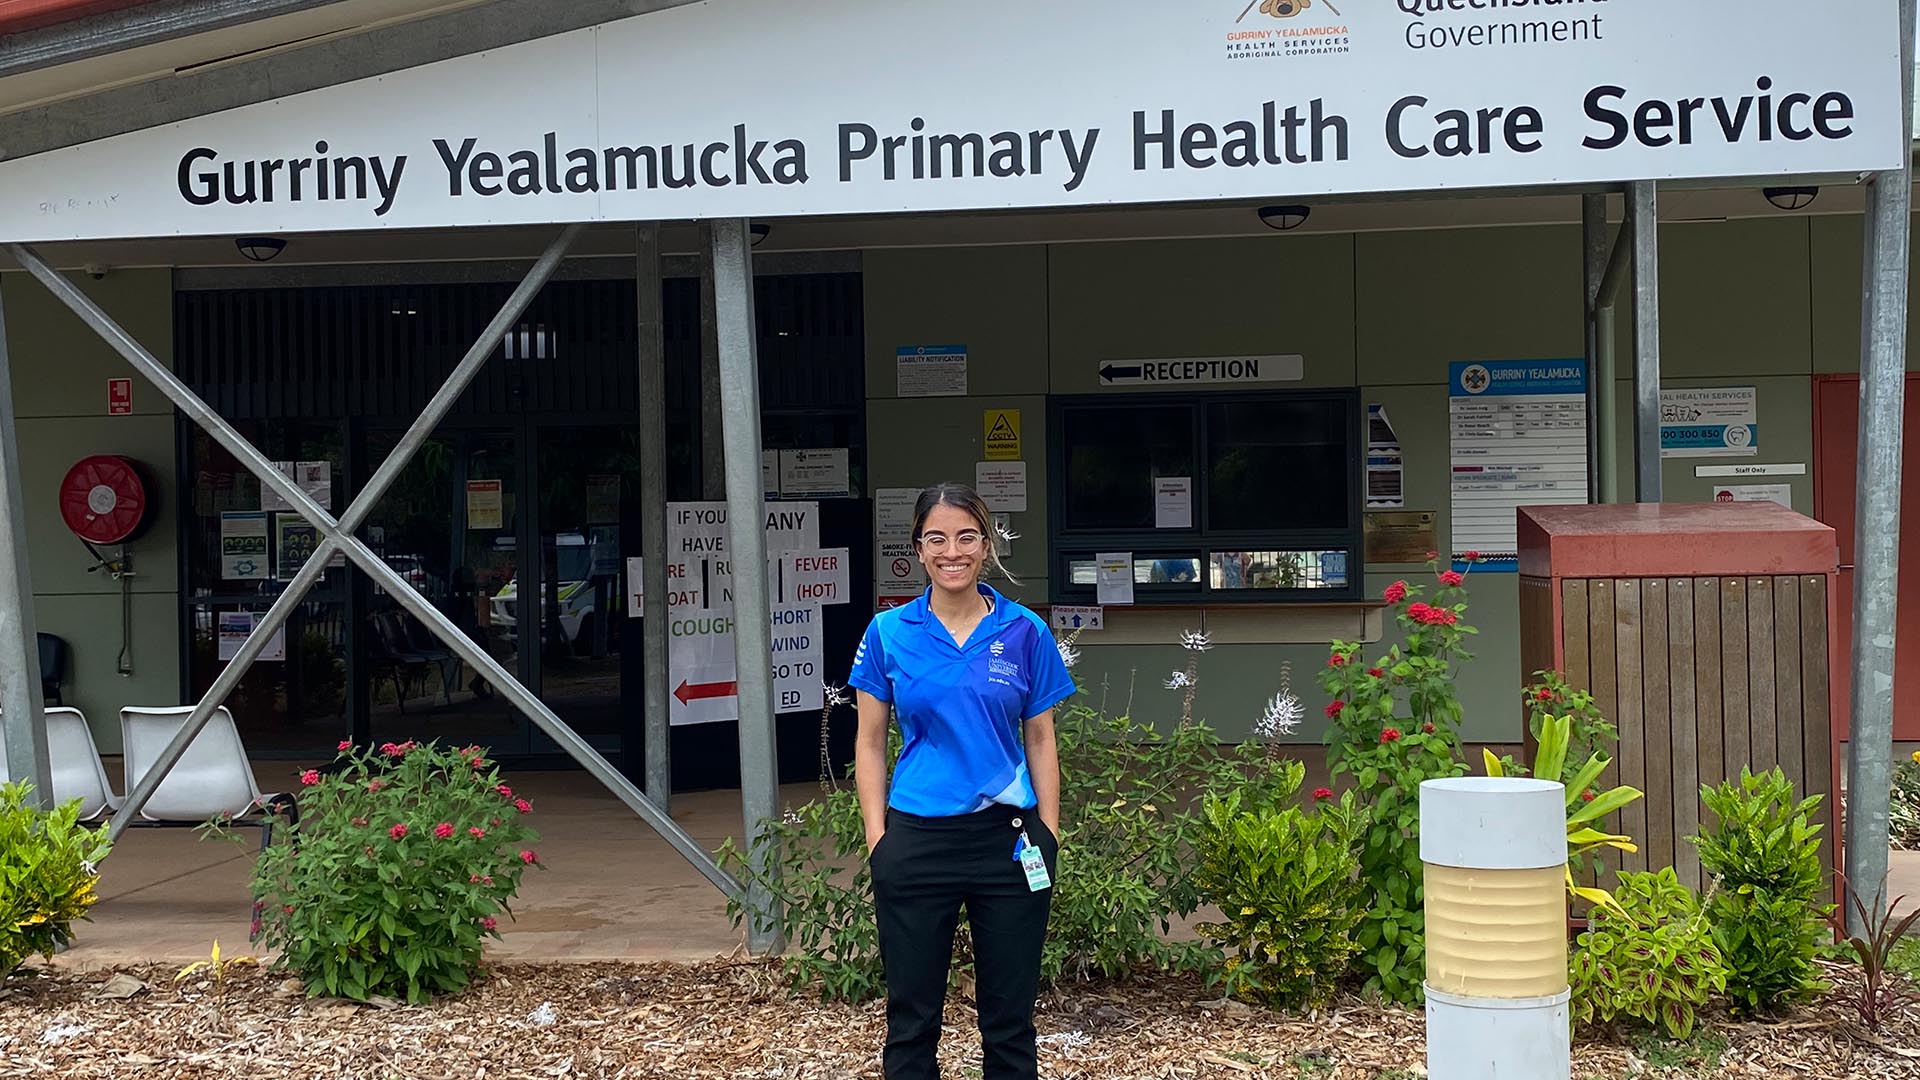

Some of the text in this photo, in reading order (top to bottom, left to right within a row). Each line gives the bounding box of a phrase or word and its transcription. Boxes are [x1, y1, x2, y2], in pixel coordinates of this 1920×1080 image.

[1227, 25, 1349, 41] GURRINY YEALAMUCKA
[1405, 13, 1603, 49] Government
[1227, 37, 1349, 51] HEALTH SERVICES
[1227, 46, 1349, 59] ABORIGINAL CORPORATION
[177, 75, 1855, 217] Gurriny Yealamucka Primary Health Care Service
[1143, 359, 1259, 381] RECEPTION
[1491, 367, 1581, 380] GURRINY YEALAMUCKA
[1676, 391, 1709, 400] HEALTH
[1711, 391, 1752, 400] SERVICES
[1679, 430, 1699, 439] 300
[1701, 429, 1720, 438] 850
[678, 510, 727, 525] IF YOU
[765, 511, 806, 531] ANY
[682, 536, 723, 552] HAVE
[795, 556, 839, 572] FEVER
[796, 582, 837, 600] (HOT)
[770, 609, 812, 626] HORT
[671, 617, 735, 637] COUGH
[794, 662, 814, 678] TO
[781, 690, 801, 707] ED
